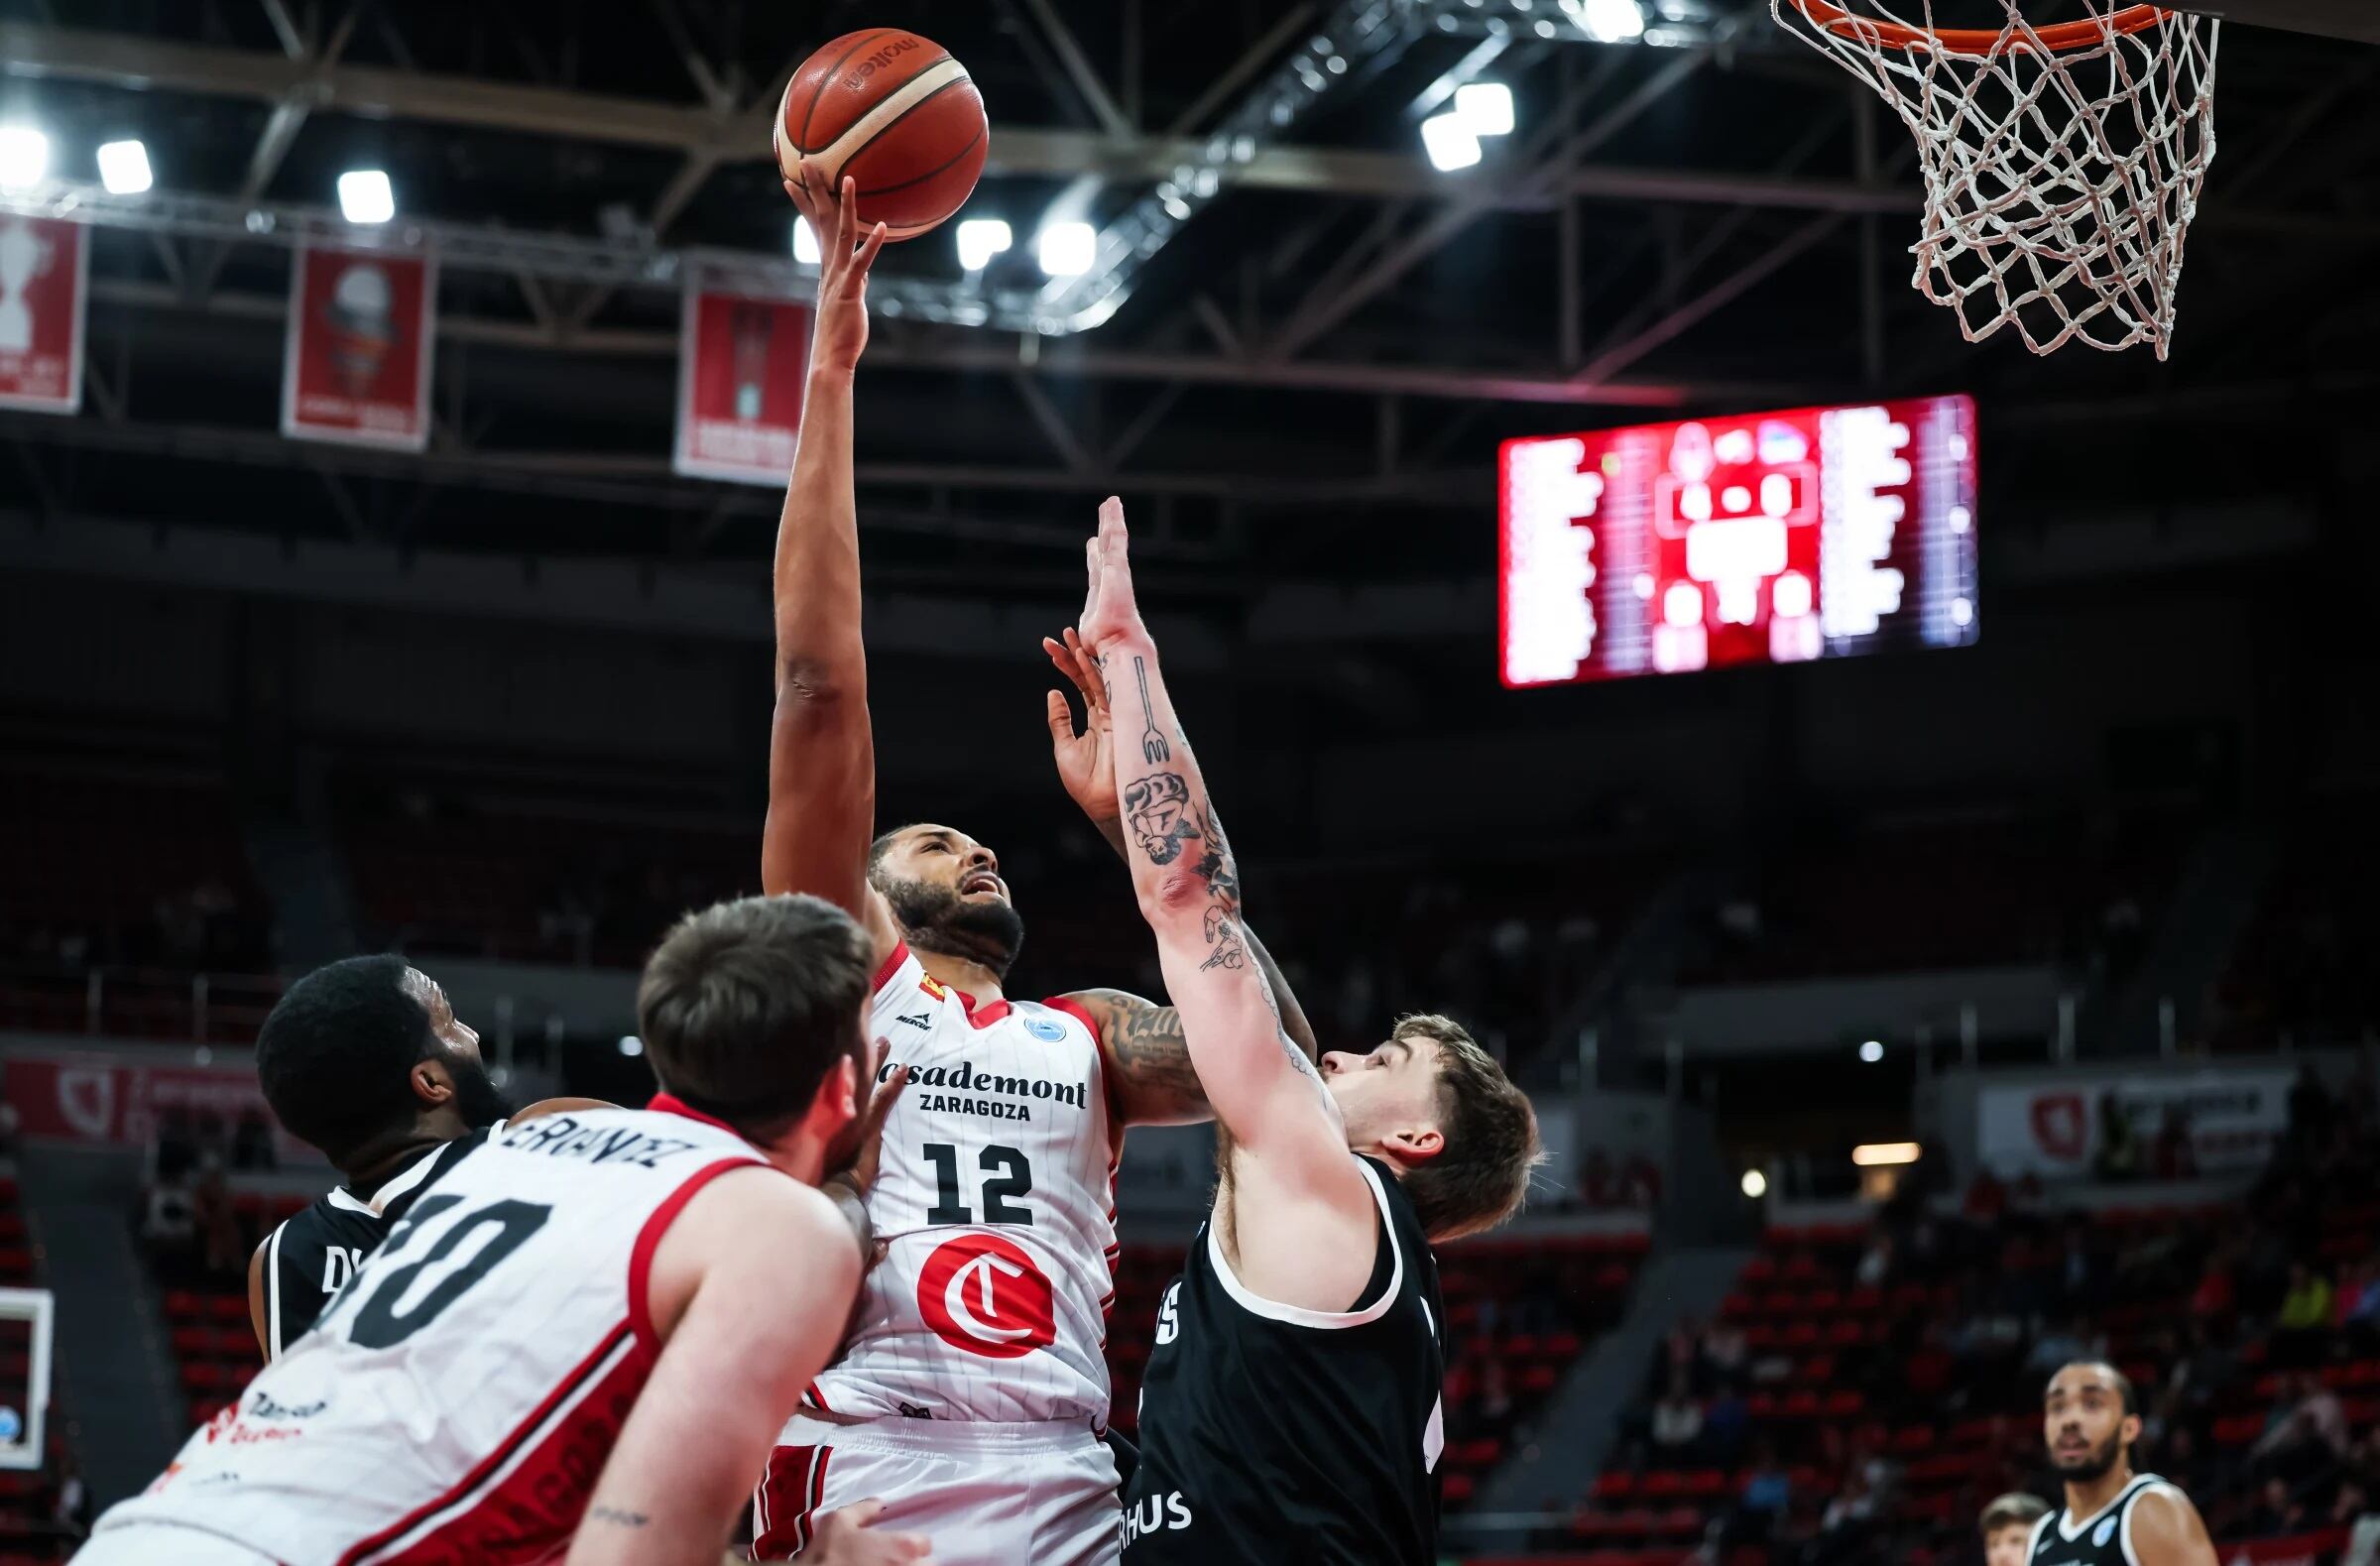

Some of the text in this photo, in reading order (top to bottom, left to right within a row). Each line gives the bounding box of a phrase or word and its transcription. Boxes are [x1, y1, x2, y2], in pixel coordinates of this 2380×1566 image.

[843, 38, 920, 90] molten
[894, 1015, 933, 1031] MERCUR
[878, 1061, 1087, 1109] asademont
[919, 1094, 1031, 1122] ZARAGOZA
[923, 1144, 1033, 1226] 12
[1119, 1491, 1192, 1555] RHUS
